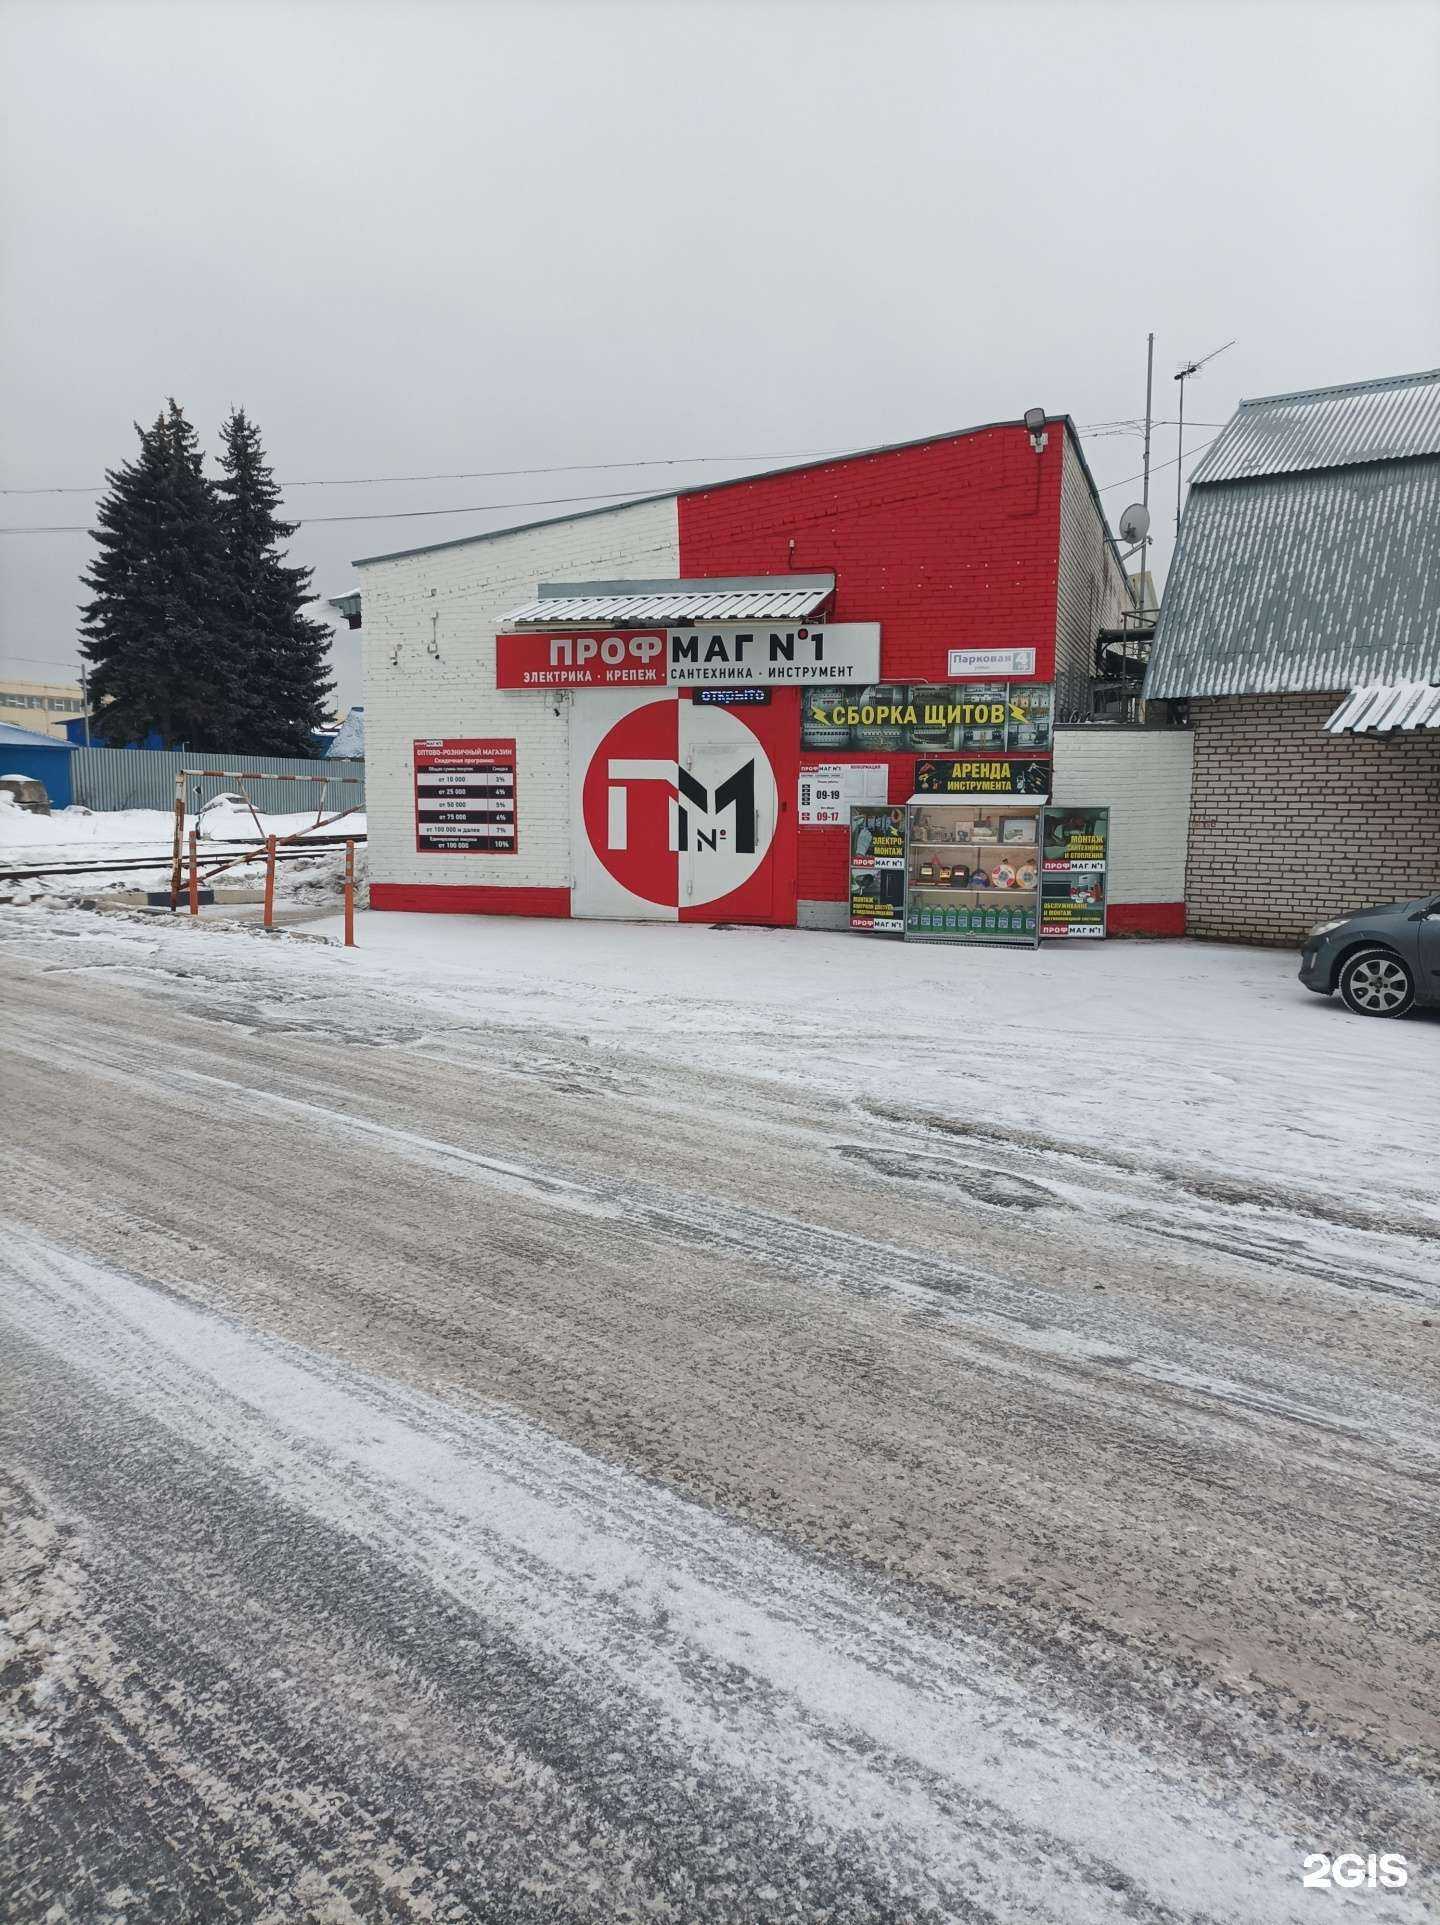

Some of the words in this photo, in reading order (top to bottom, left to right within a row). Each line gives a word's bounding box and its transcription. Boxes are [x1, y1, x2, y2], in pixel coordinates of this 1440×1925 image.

[550, 636, 663, 666] ПРОФ
[672, 634, 754, 663] МАГ
[953, 655, 1011, 665] Парковая
[523, 670, 593, 683] ЭЛЕКТРИКА
[606, 669, 657, 681] КРЕПЕЖ
[671, 667, 753, 680] САНТЕХНИКА
[768, 666, 854, 679] ИНСТРУМЕНТ
[832, 705, 917, 725] СБОРКА
[924, 704, 1005, 727] ЩИТОВ
[952, 763, 1011, 780] АРЕНДА
[947, 781, 1012, 792] ИНСТРУМЕНТА
[816, 790, 840, 800] 09-19
[816, 812, 839, 821] 09-17
[1070, 834, 1104, 844] МОНТАЖ
[874, 846, 903, 856] МОНТАЖ
